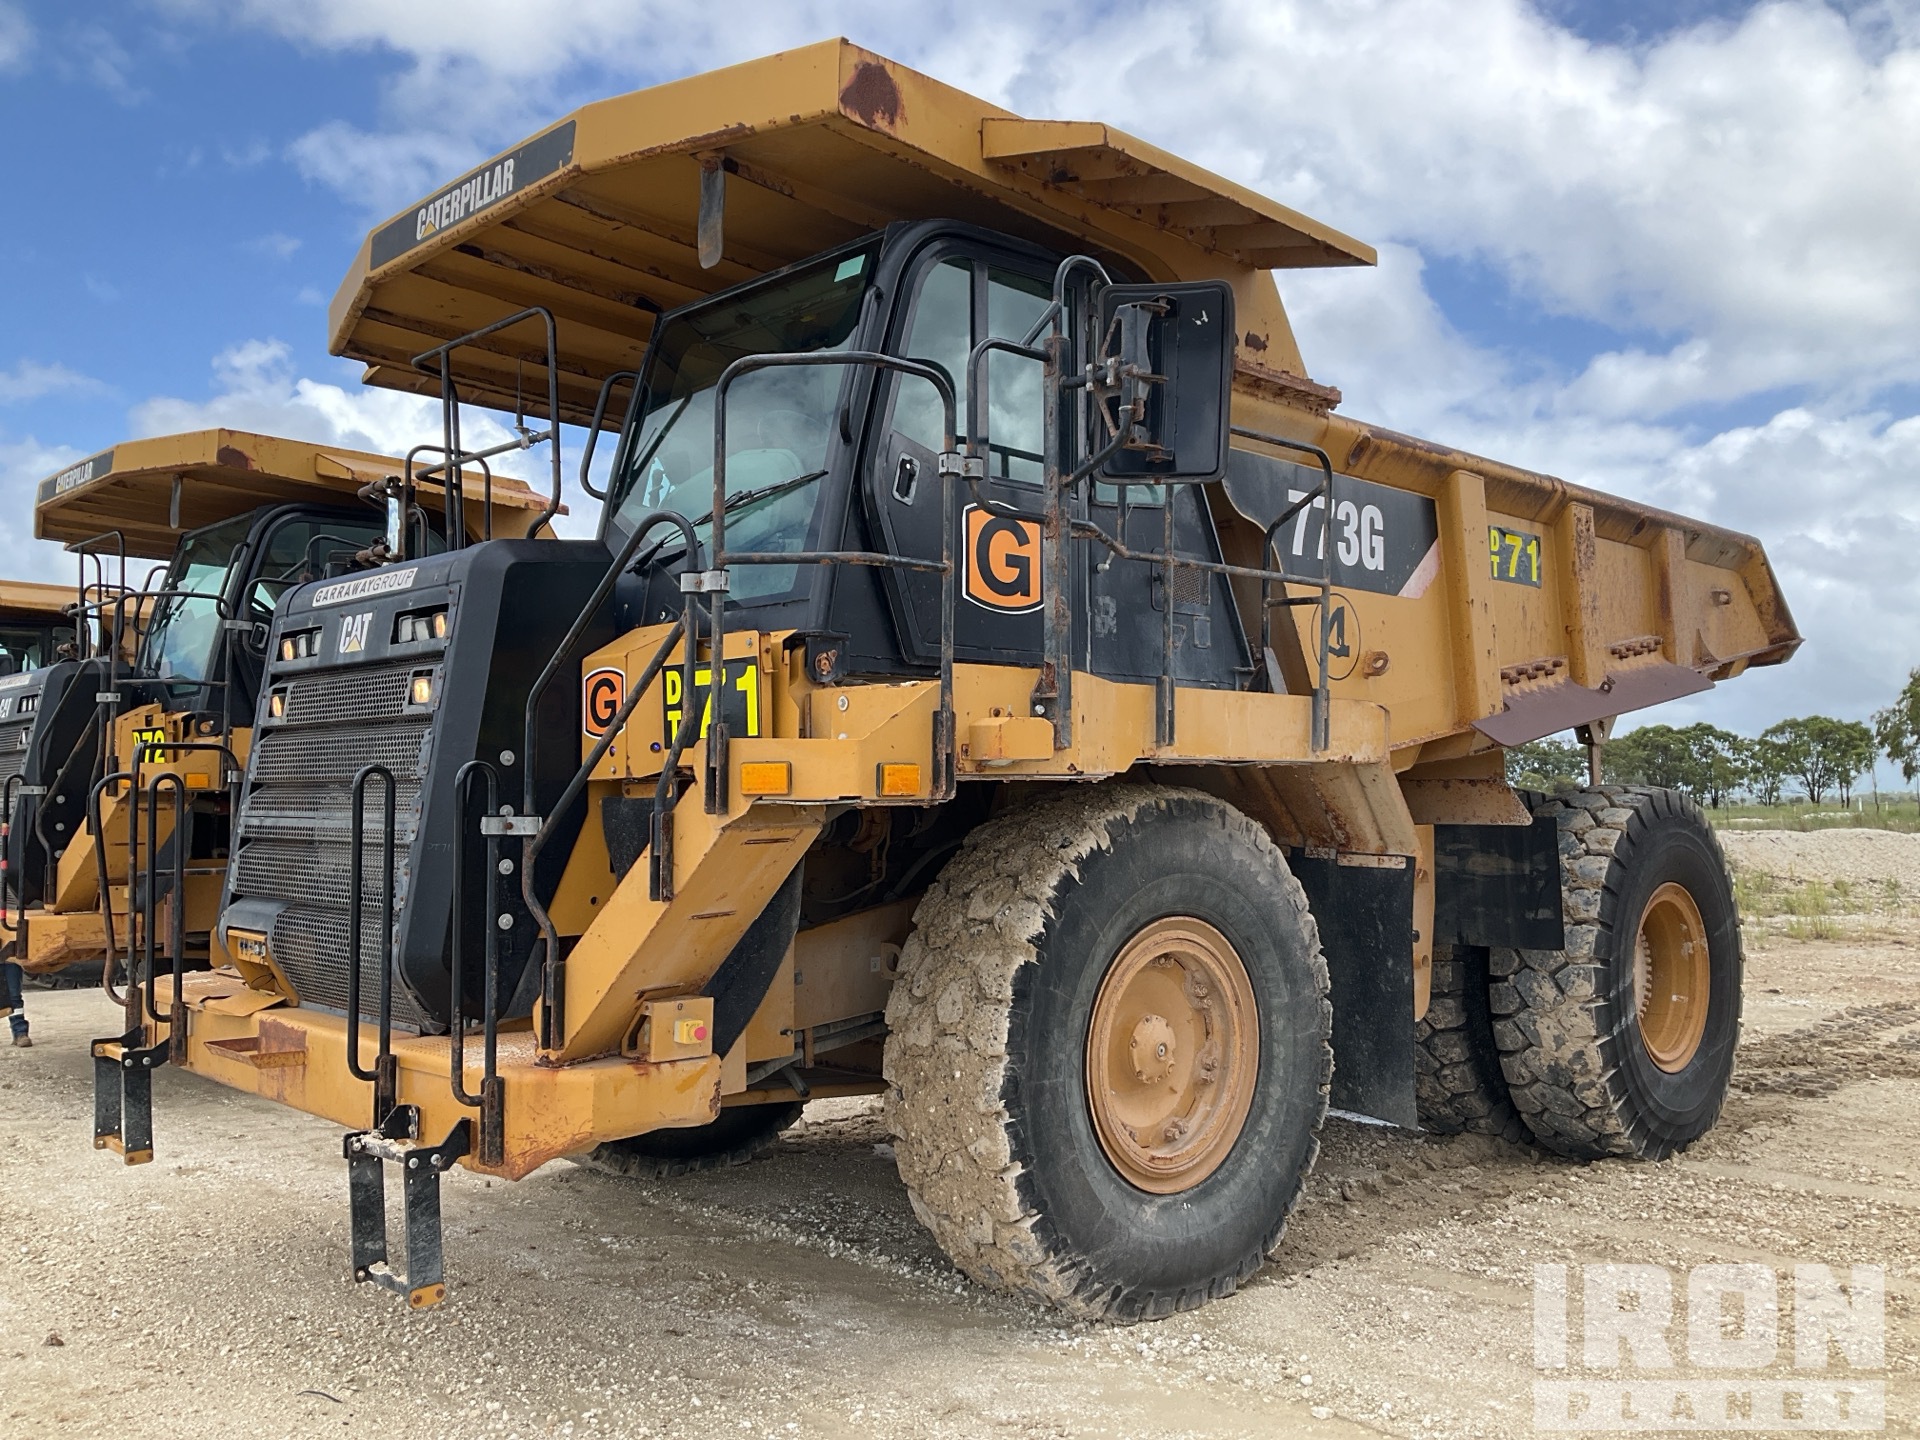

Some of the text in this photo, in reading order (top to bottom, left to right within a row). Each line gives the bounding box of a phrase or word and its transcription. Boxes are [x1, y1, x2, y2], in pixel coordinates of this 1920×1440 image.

[416, 158, 514, 241] CATERPILLAR
[976, 515, 1031, 597] G
[1288, 489, 1385, 571] 773G
[1505, 533, 1537, 582] 71
[340, 612, 373, 653] CAT
[589, 677, 617, 728] G
